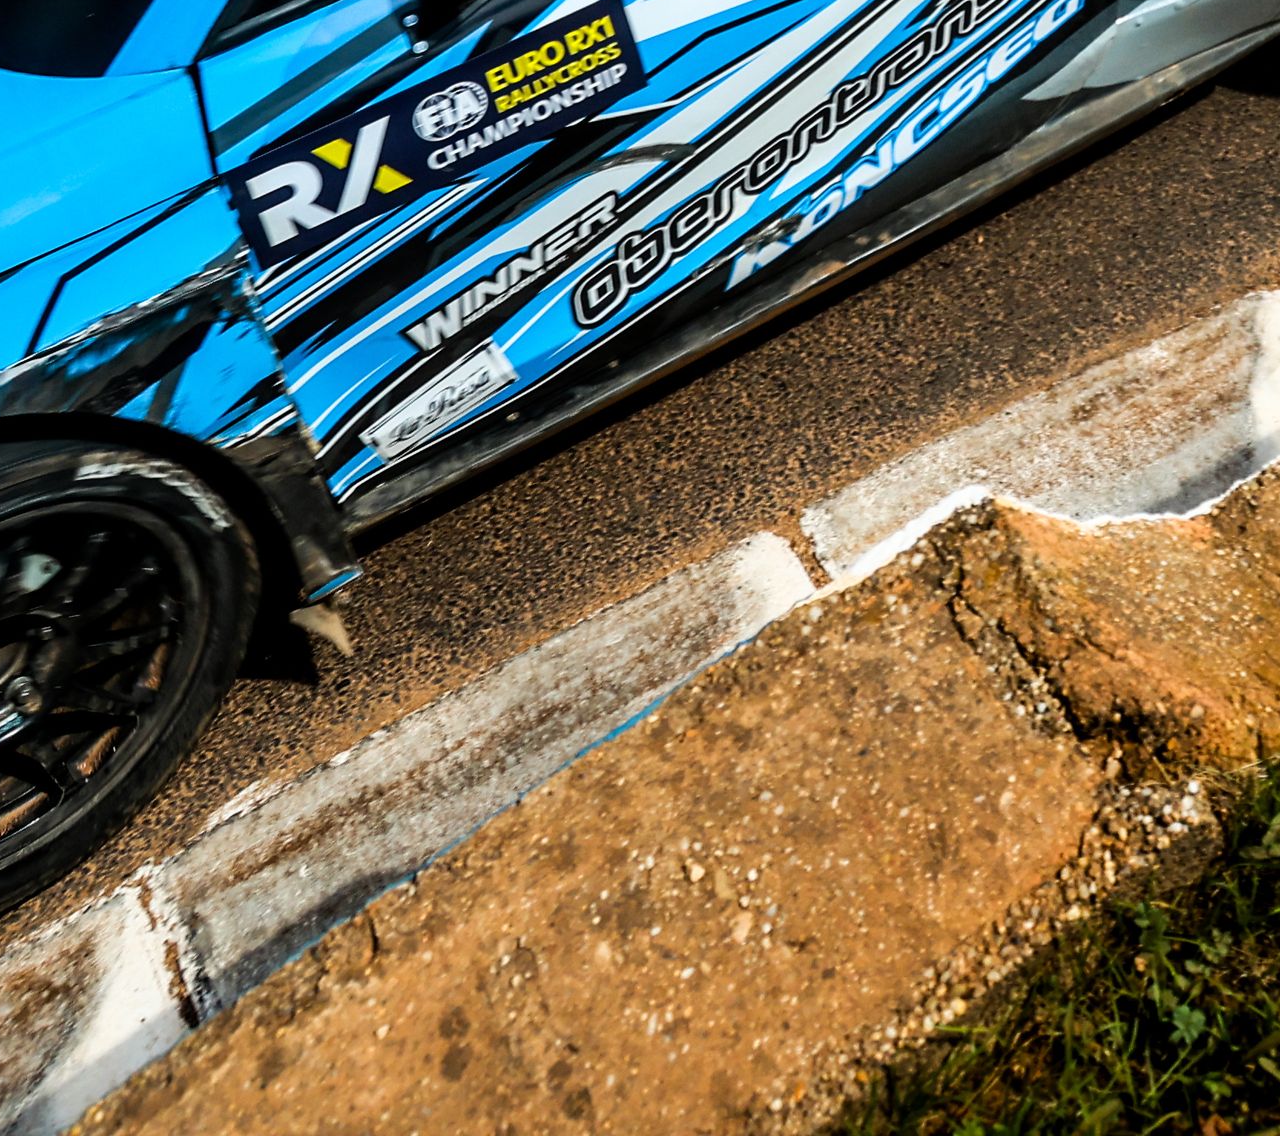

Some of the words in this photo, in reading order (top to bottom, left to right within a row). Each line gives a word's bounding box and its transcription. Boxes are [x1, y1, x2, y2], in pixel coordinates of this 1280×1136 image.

[484, 39, 566, 94] EURO
[564, 14, 616, 56] RX1
[494, 41, 622, 114] RALLYCROSS
[414, 85, 485, 140] FIA
[426, 62, 628, 170] CHAMPIONSHIP
[246, 115, 413, 248] RX
[406, 193, 617, 352] WINNER
